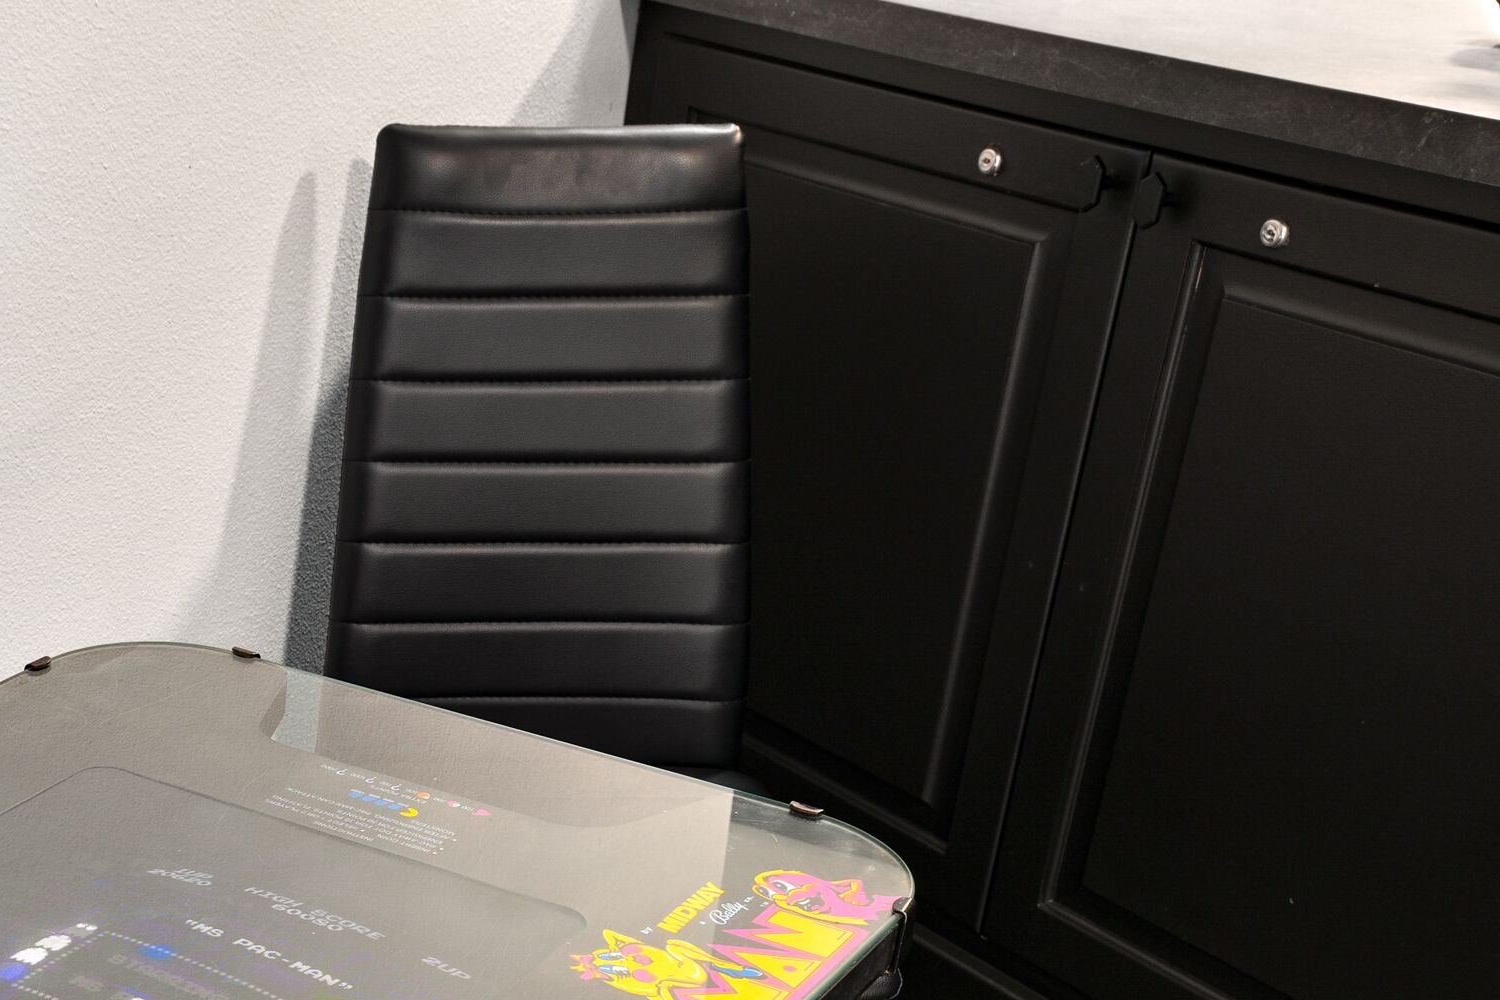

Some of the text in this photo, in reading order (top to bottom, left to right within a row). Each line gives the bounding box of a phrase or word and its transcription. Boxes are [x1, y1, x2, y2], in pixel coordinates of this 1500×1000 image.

[244, 886, 386, 940] HIGH SCORE
[656, 881, 725, 934] MIDWAY
[708, 901, 749, 926] Bally
[421, 956, 470, 979] 2UP
